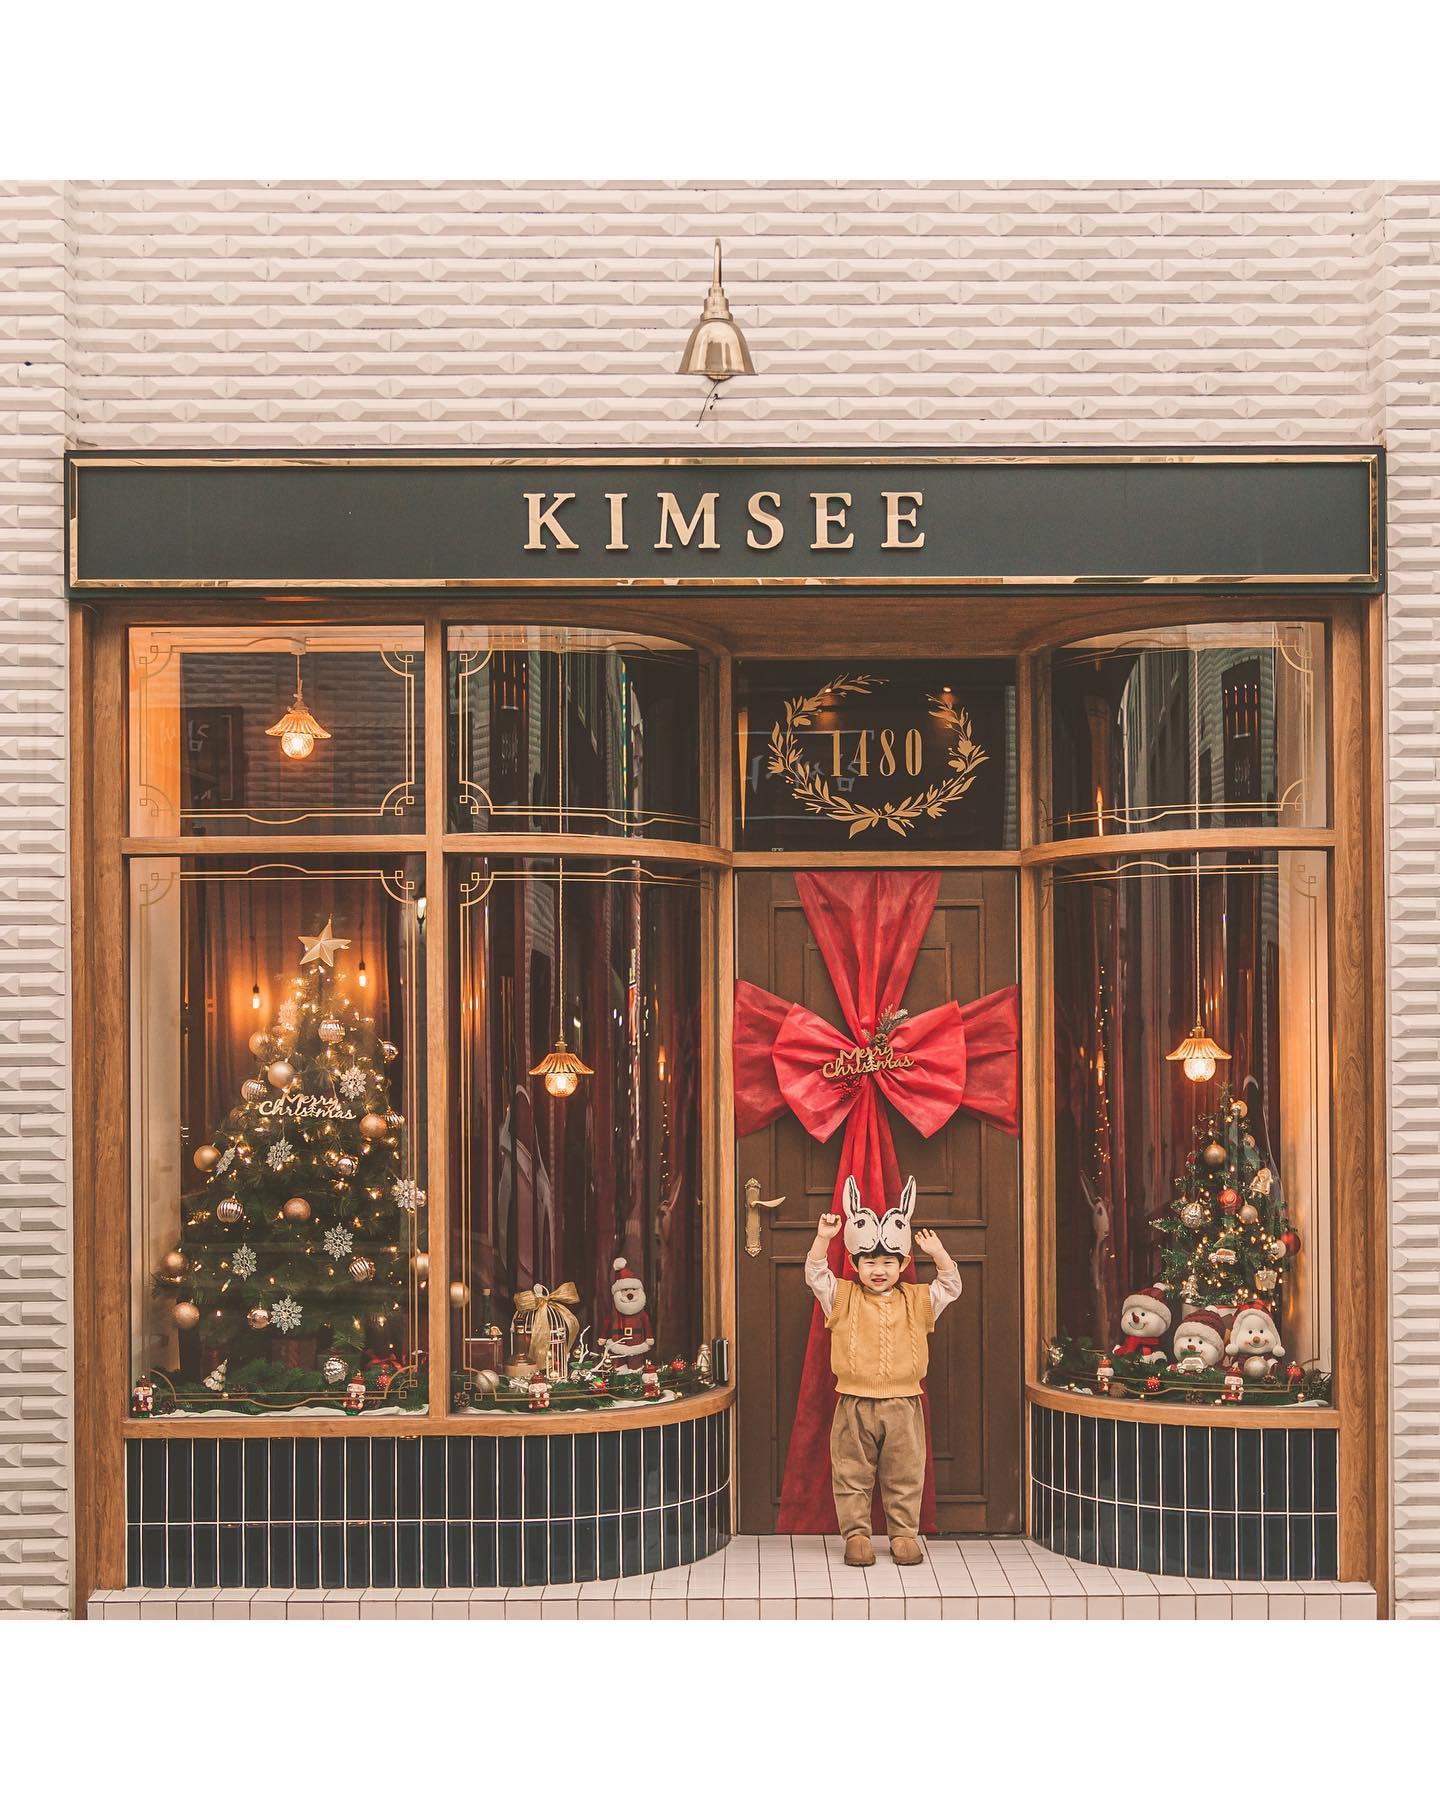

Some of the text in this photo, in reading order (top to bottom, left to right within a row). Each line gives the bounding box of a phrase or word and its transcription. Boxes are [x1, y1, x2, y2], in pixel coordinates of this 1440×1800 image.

[523, 491, 926, 550] KIMSEE
[830, 728, 923, 777] 1480
[839, 1046, 894, 1067] Merry
[282, 1093, 341, 1110] Merry
